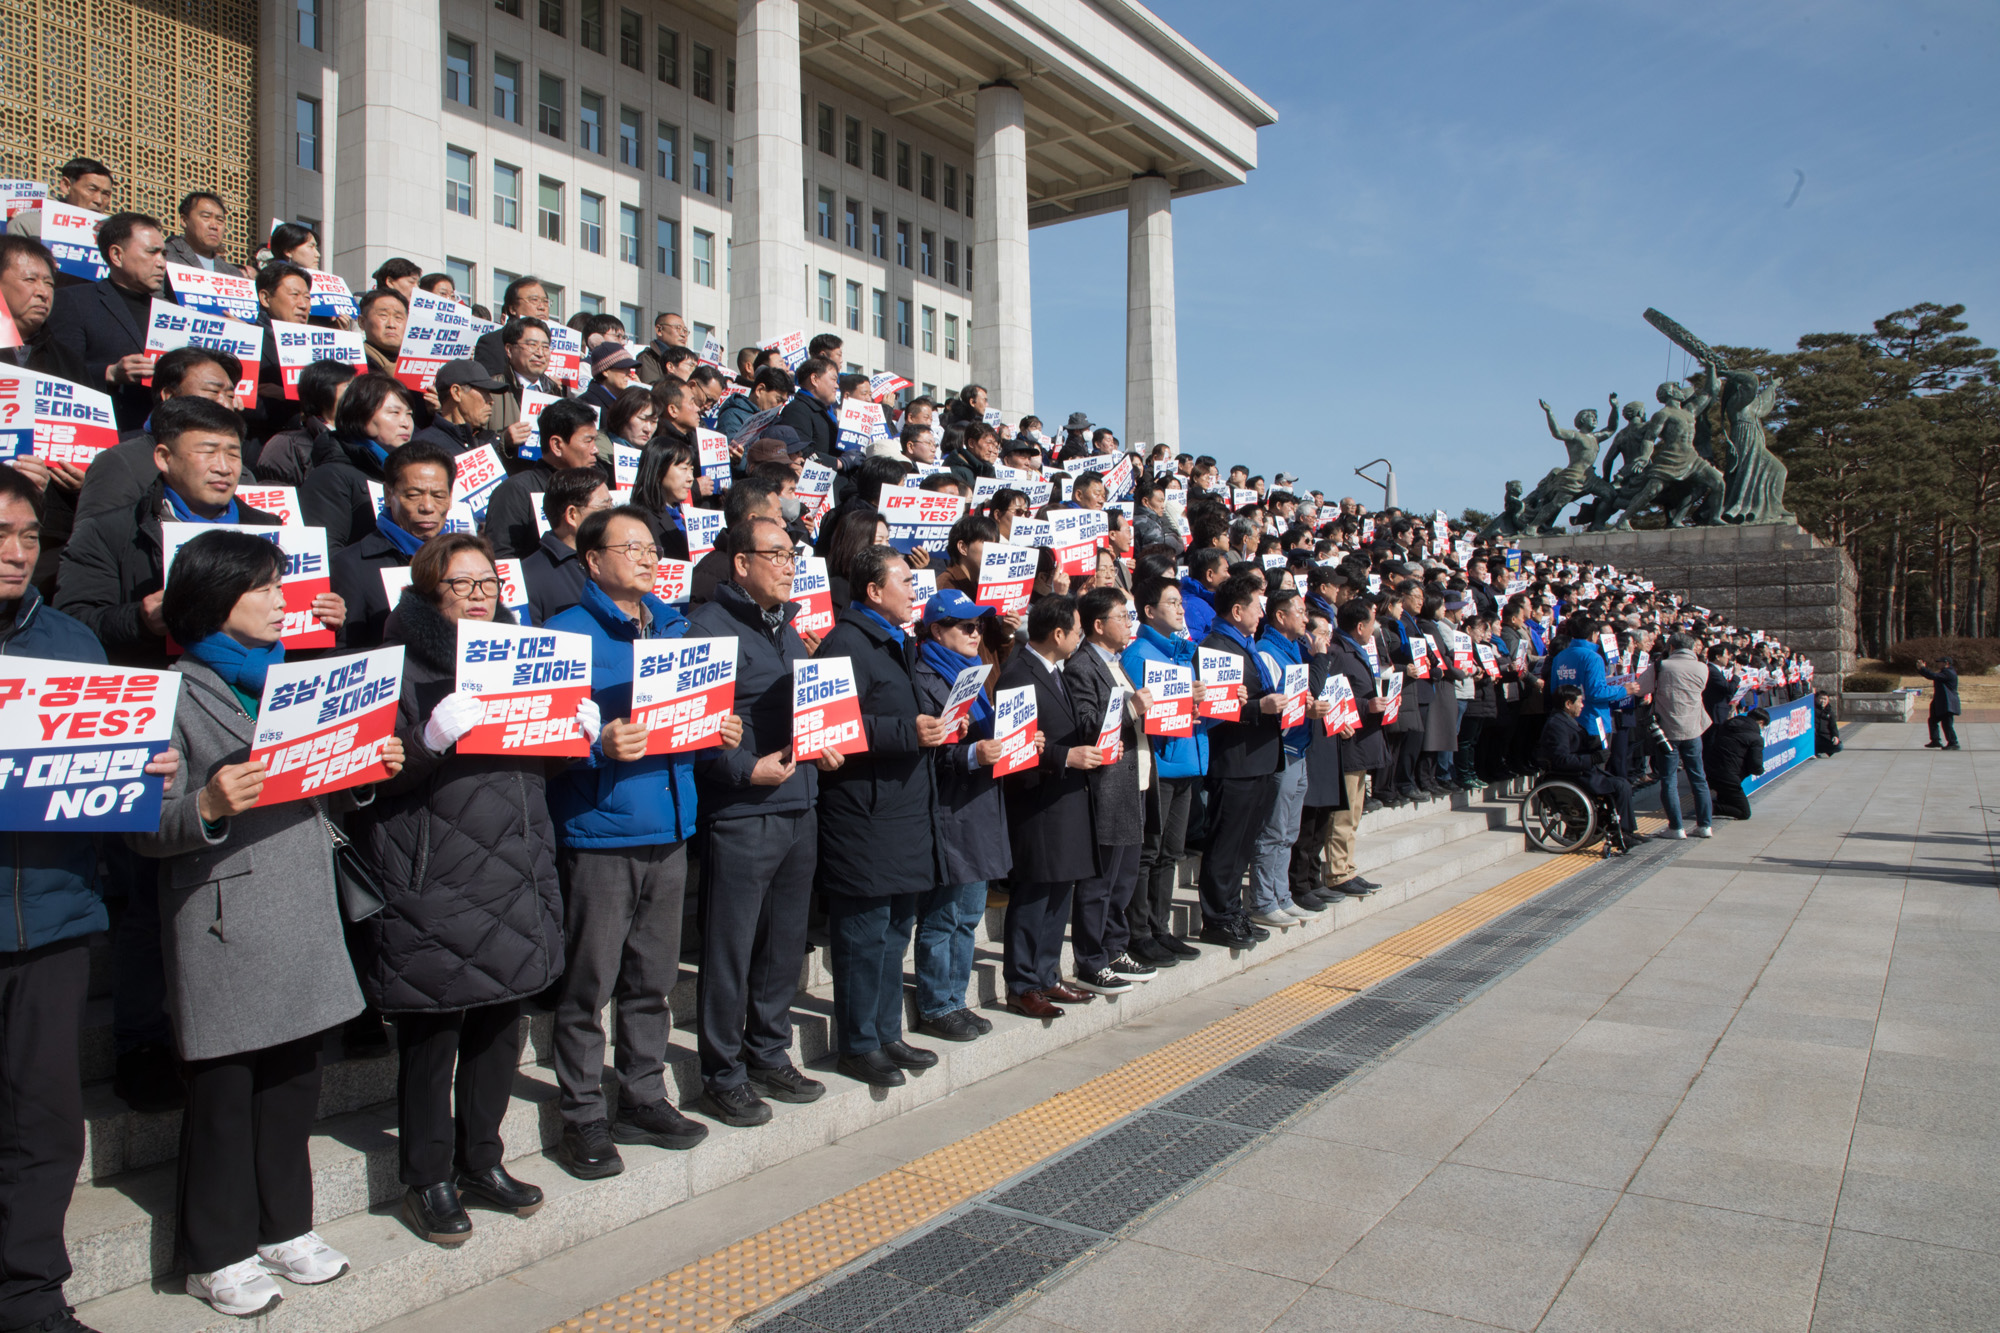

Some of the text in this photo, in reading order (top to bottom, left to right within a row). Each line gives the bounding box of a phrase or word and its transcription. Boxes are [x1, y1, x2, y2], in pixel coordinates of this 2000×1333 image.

[0, 182, 33, 192] 남·대전
[178, 272, 250, 289] 대구·경북은
[317, 283, 347, 294] YES?
[213, 286, 253, 298] YES?
[334, 305, 359, 317] NO?
[413, 296, 456, 313] 충남·대전
[228, 308, 259, 320] NO?
[434, 312, 470, 327] 홀대하는
[154, 313, 226, 336] 충남·대전
[280, 332, 336, 347] 충남·대전
[407, 326, 461, 342] 충남·대전
[187, 335, 257, 356] 홀대하는
[312, 347, 361, 361] 홀대하는
[430, 343, 472, 356] 홀대하는
[34, 398, 110, 423] 홀대하는
[701, 437, 728, 451] 대구·경북은
[715, 450, 729, 461] YES?
[1067, 458, 1098, 472] 충남·대전
[459, 462, 496, 493] YES?
[802, 468, 831, 482] 충남·대전
[886, 496, 959, 509] 대구·경북은
[687, 514, 720, 532] 충남·대전
[919, 511, 957, 522] YES?
[1055, 512, 1092, 533] 충남·대전
[1013, 524, 1050, 537] 충남·대전
[922, 540, 949, 554] NO?
[985, 550, 1028, 567] 충남·대전
[1008, 563, 1036, 579] 홀대하는
[980, 582, 1024, 601] 내란잔당
[465, 635, 557, 664] 충남·대전
[639, 642, 711, 678] 충남·대전
[1202, 656, 1232, 670] 충남·대전
[512, 659, 587, 687] 홀대하는
[676, 660, 733, 693] 홀대하는
[1147, 669, 1178, 684] 충남·대전
[1216, 668, 1242, 682] 홀대하는
[1556, 668, 1577, 680] 민주당
[268, 657, 369, 712] 충남·대전
[461, 682, 484, 693] 민주당
[796, 677, 851, 708] 홀대하는
[1163, 681, 1191, 698] 홀대하는
[316, 676, 397, 725] 홀대하는
[636, 694, 653, 704] 민주당
[996, 690, 1026, 720] 충남·대전
[1210, 698, 1240, 715] 규탄한다
[636, 694, 708, 731] 내란잔당
[1012, 702, 1036, 729] 홀대하는
[38, 707, 156, 741] YES?
[671, 708, 730, 749] 규탄한다
[1160, 713, 1192, 733] 규탄한다
[259, 731, 284, 742] 민주당
[502, 715, 585, 750] 규탄한다
[796, 719, 860, 757] 규탄한다
[259, 722, 360, 778] 내란잔당
[300, 733, 392, 793] 규탄한다
[44, 781, 145, 821] NO?
